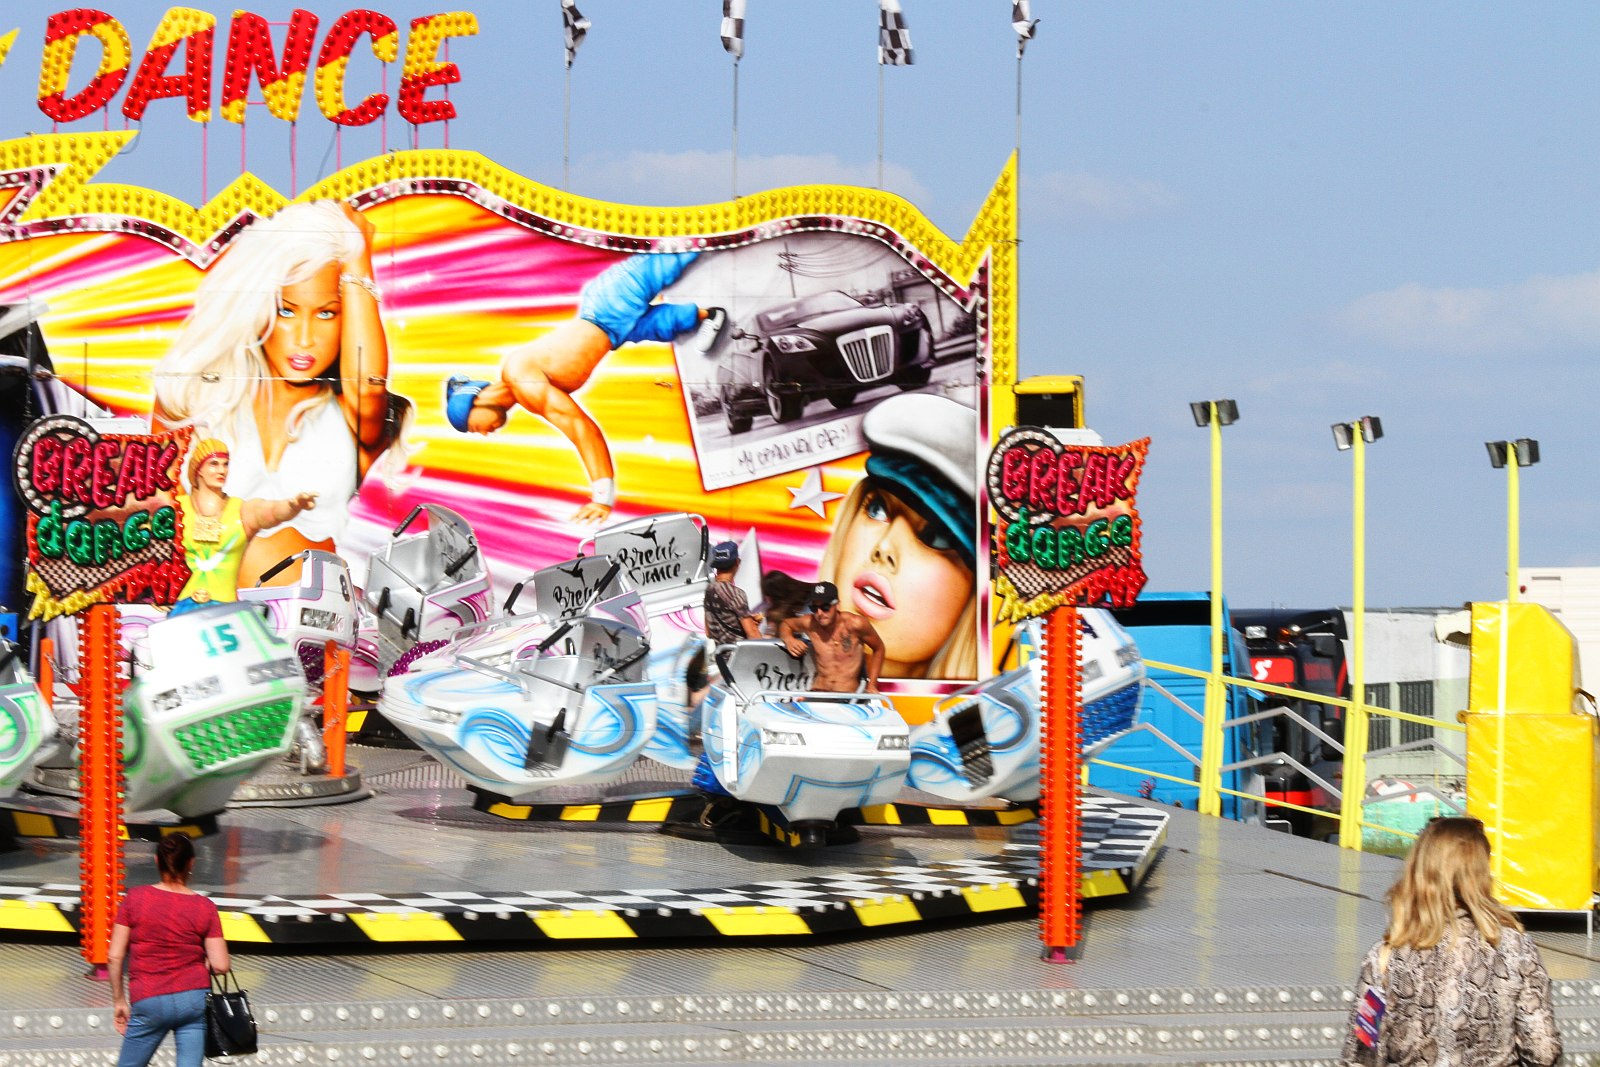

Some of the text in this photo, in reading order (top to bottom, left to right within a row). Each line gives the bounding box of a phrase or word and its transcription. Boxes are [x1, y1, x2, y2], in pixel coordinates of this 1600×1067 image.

[37, 7, 479, 126] DANCE
[33, 436, 178, 508] BREAK
[1003, 447, 1136, 515] BREAK
[37, 500, 176, 564] dance
[1005, 507, 1133, 569] dance
[200, 623, 239, 657] 15
